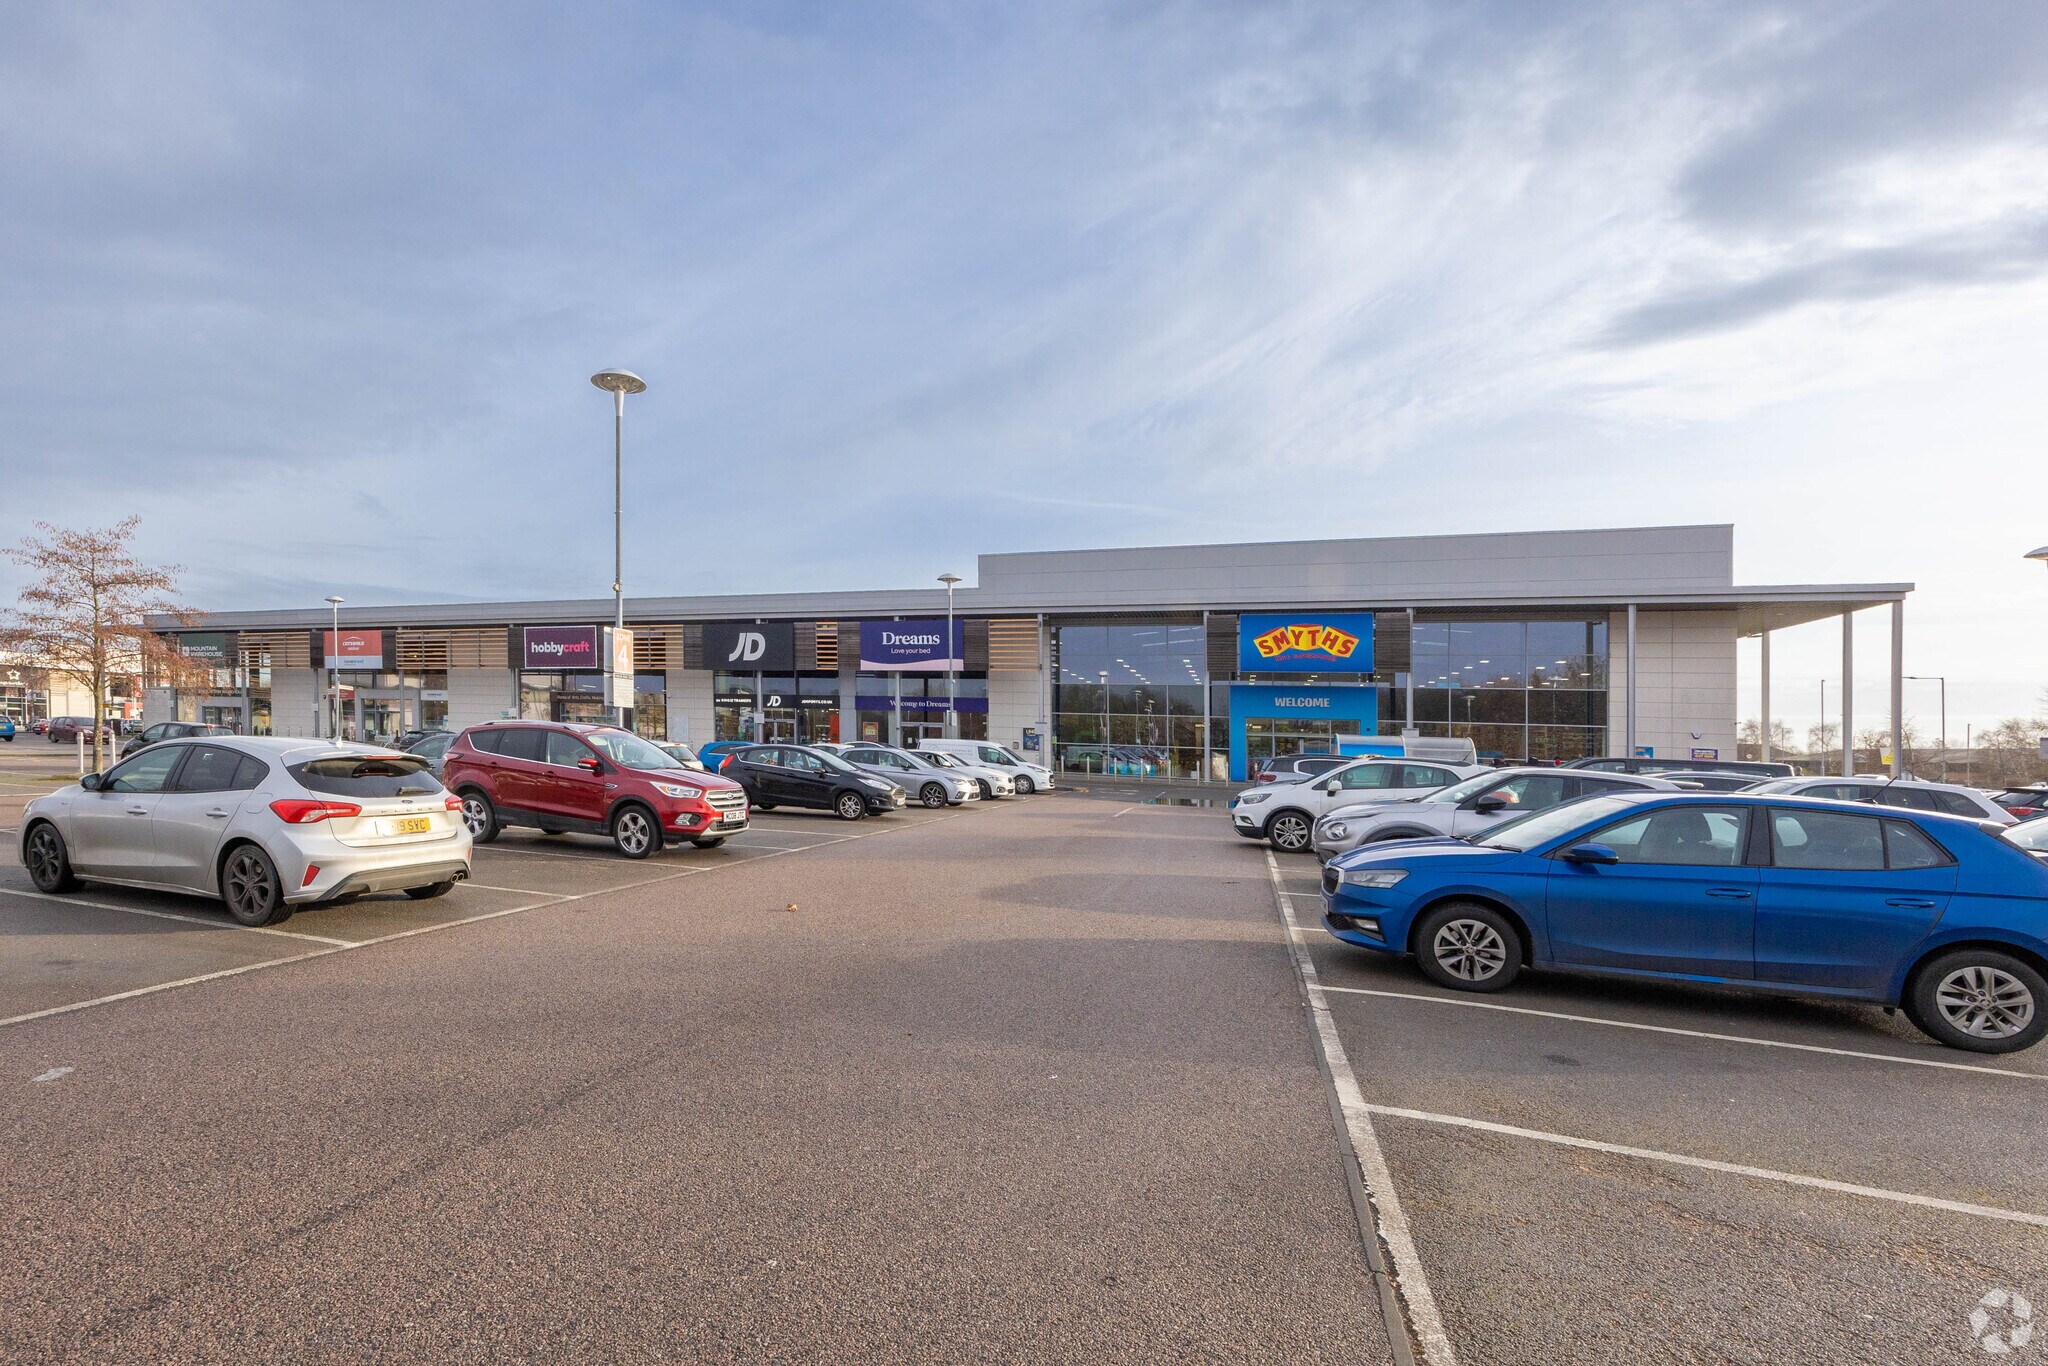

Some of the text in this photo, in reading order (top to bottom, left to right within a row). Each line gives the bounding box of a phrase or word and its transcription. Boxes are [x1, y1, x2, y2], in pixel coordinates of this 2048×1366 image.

[882, 632, 941, 645] Dreams
[1258, 629, 1355, 655] SMYTHS
[531, 641, 590, 656] hobbycraft
[728, 632, 766, 662] JD
[618, 645, 628, 668] 4
[767, 695, 781, 707] JD
[1275, 697, 1330, 708] WELCOME
